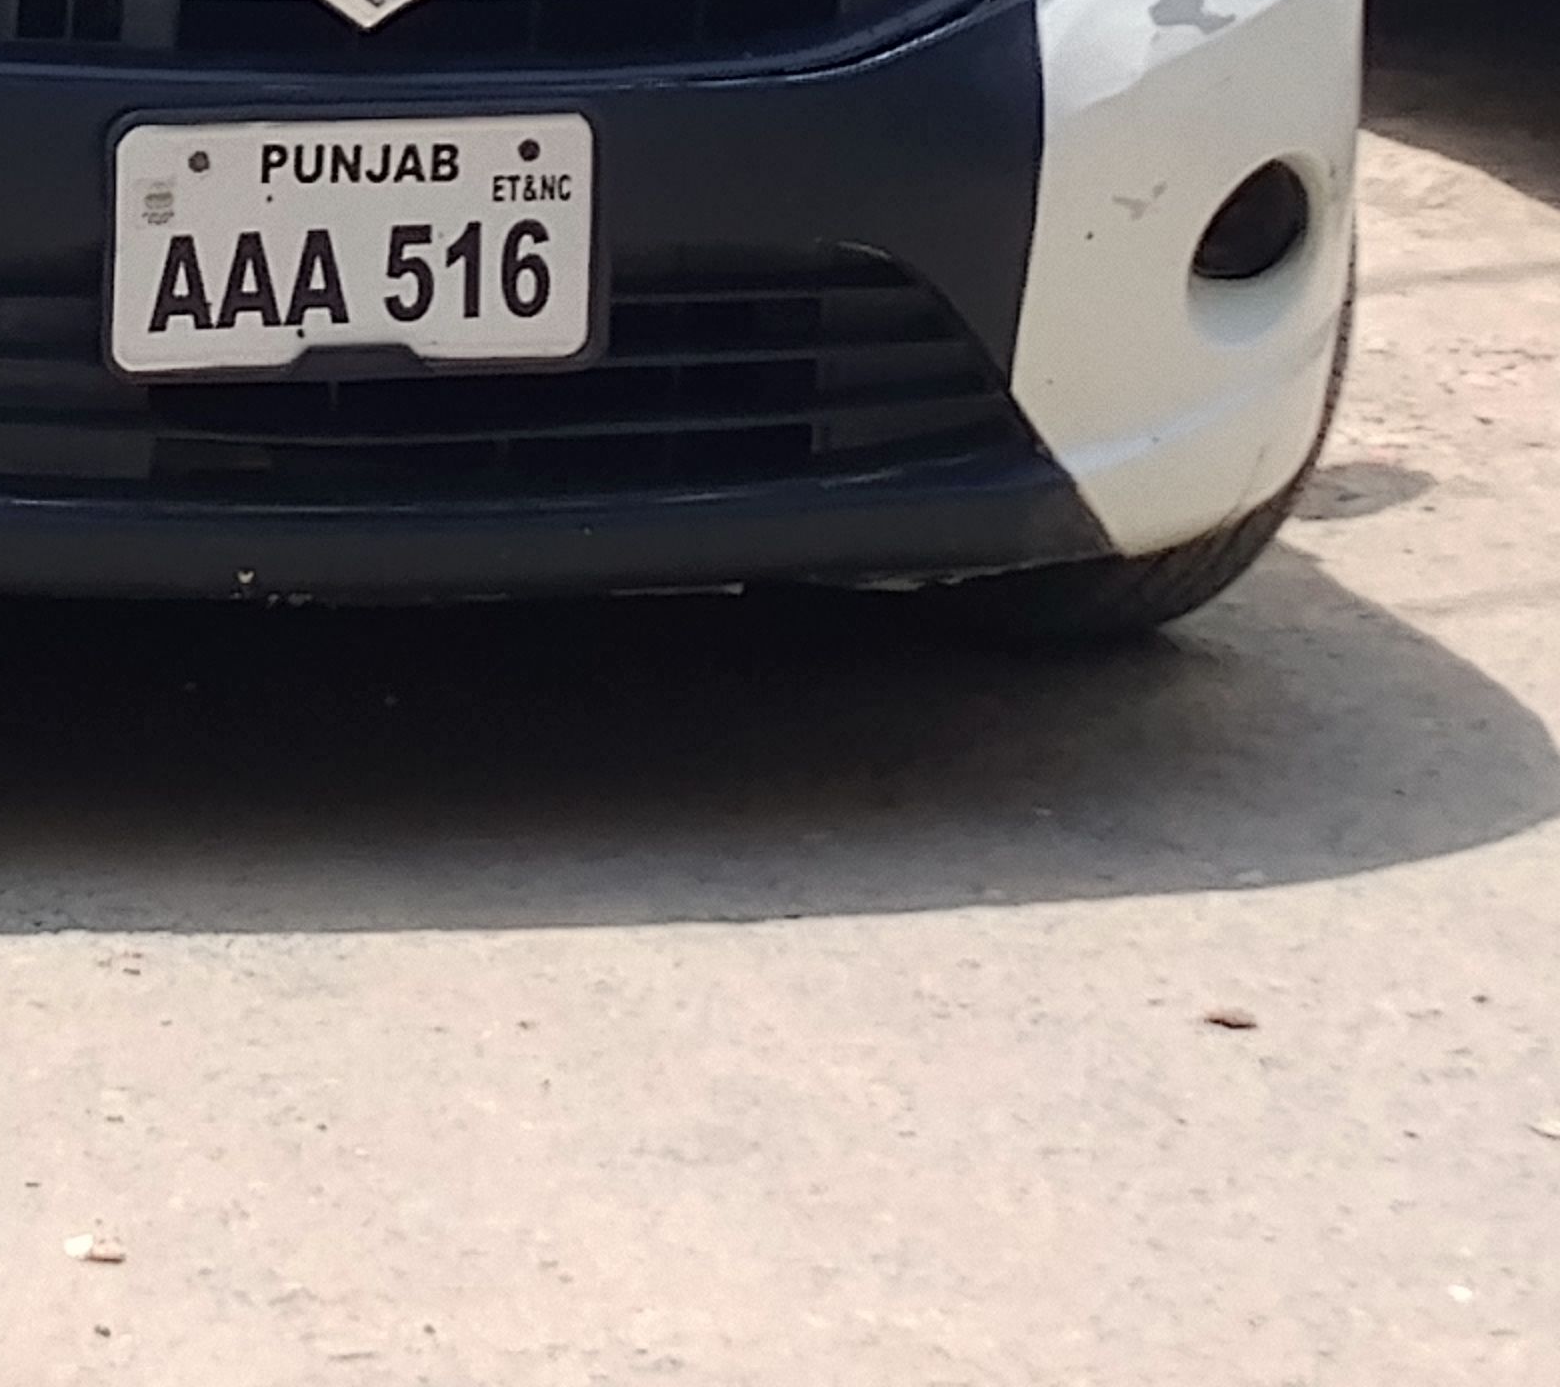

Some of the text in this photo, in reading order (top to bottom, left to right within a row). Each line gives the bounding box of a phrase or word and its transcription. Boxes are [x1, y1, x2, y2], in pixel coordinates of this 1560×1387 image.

[260, 143, 460, 184] PUNJAB
[492, 174, 572, 203] ET&NC
[147, 219, 551, 333] AAA 516
